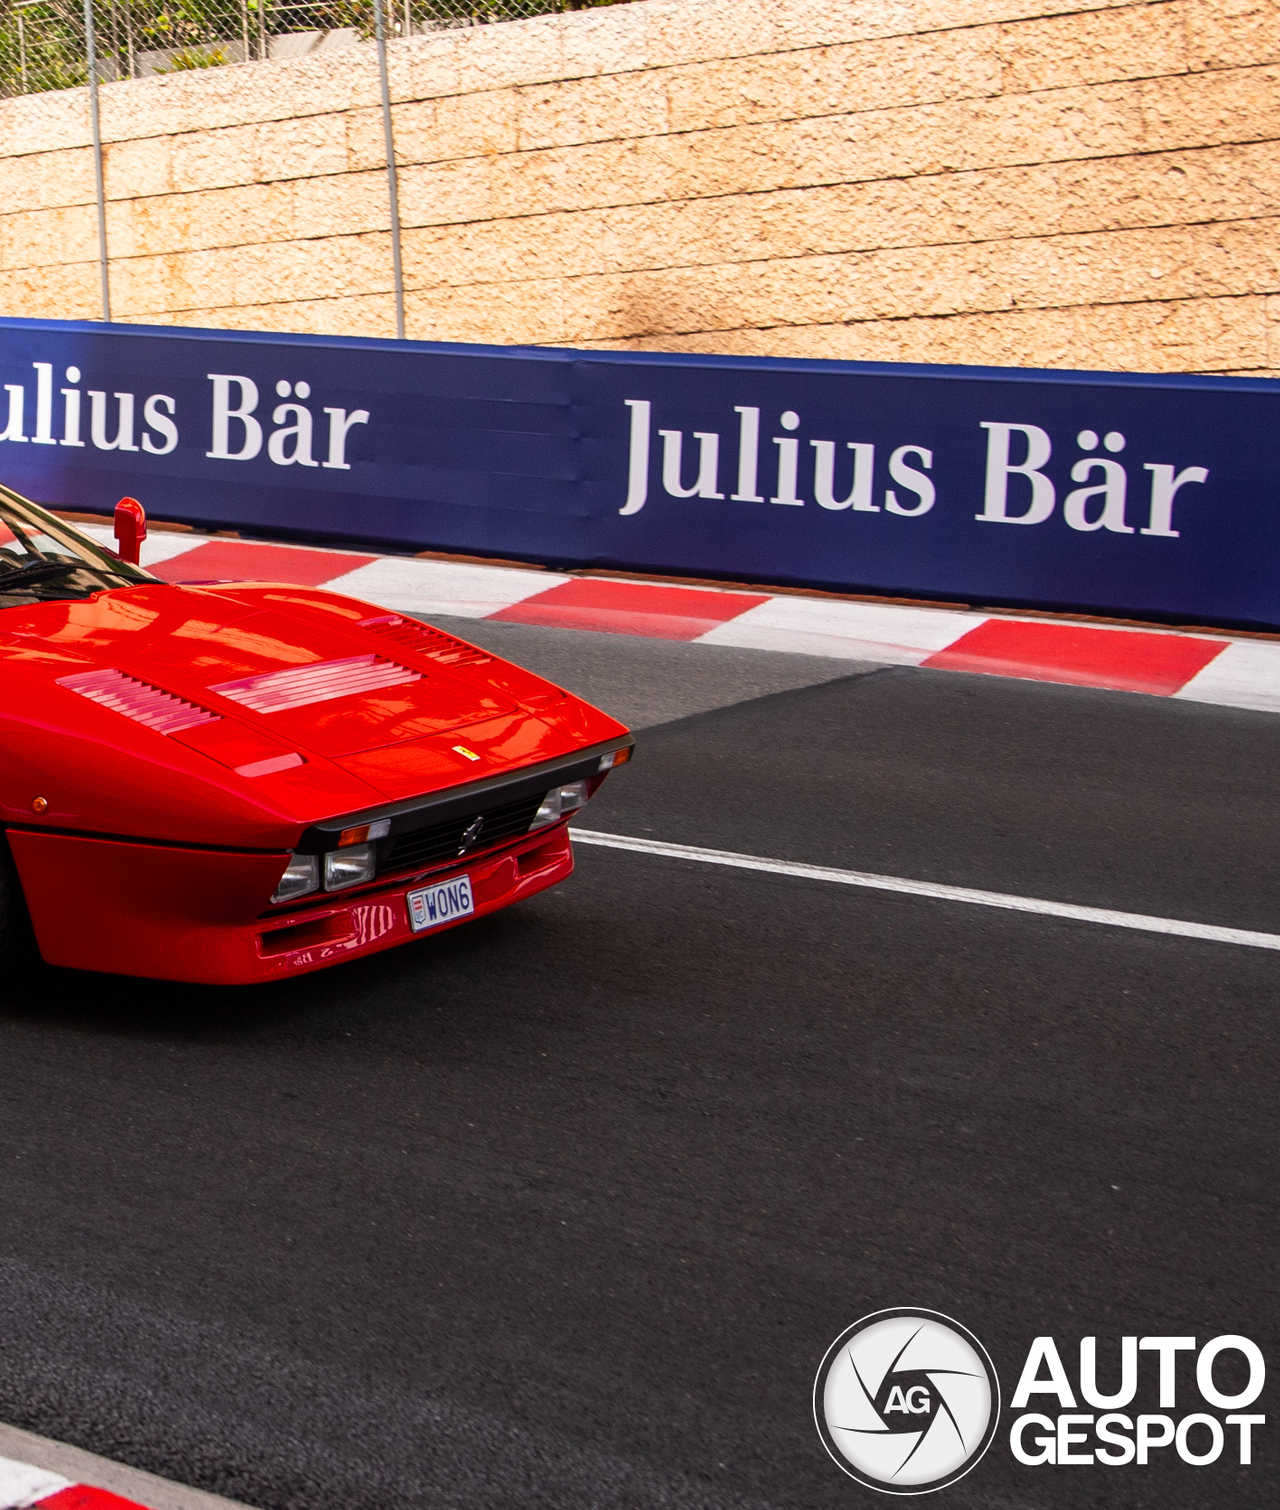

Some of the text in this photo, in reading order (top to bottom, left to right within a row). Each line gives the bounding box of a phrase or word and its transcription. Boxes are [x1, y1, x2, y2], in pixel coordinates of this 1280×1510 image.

[205, 373, 370, 470] Bär
[619, 399, 1209, 538] Julius Bär
